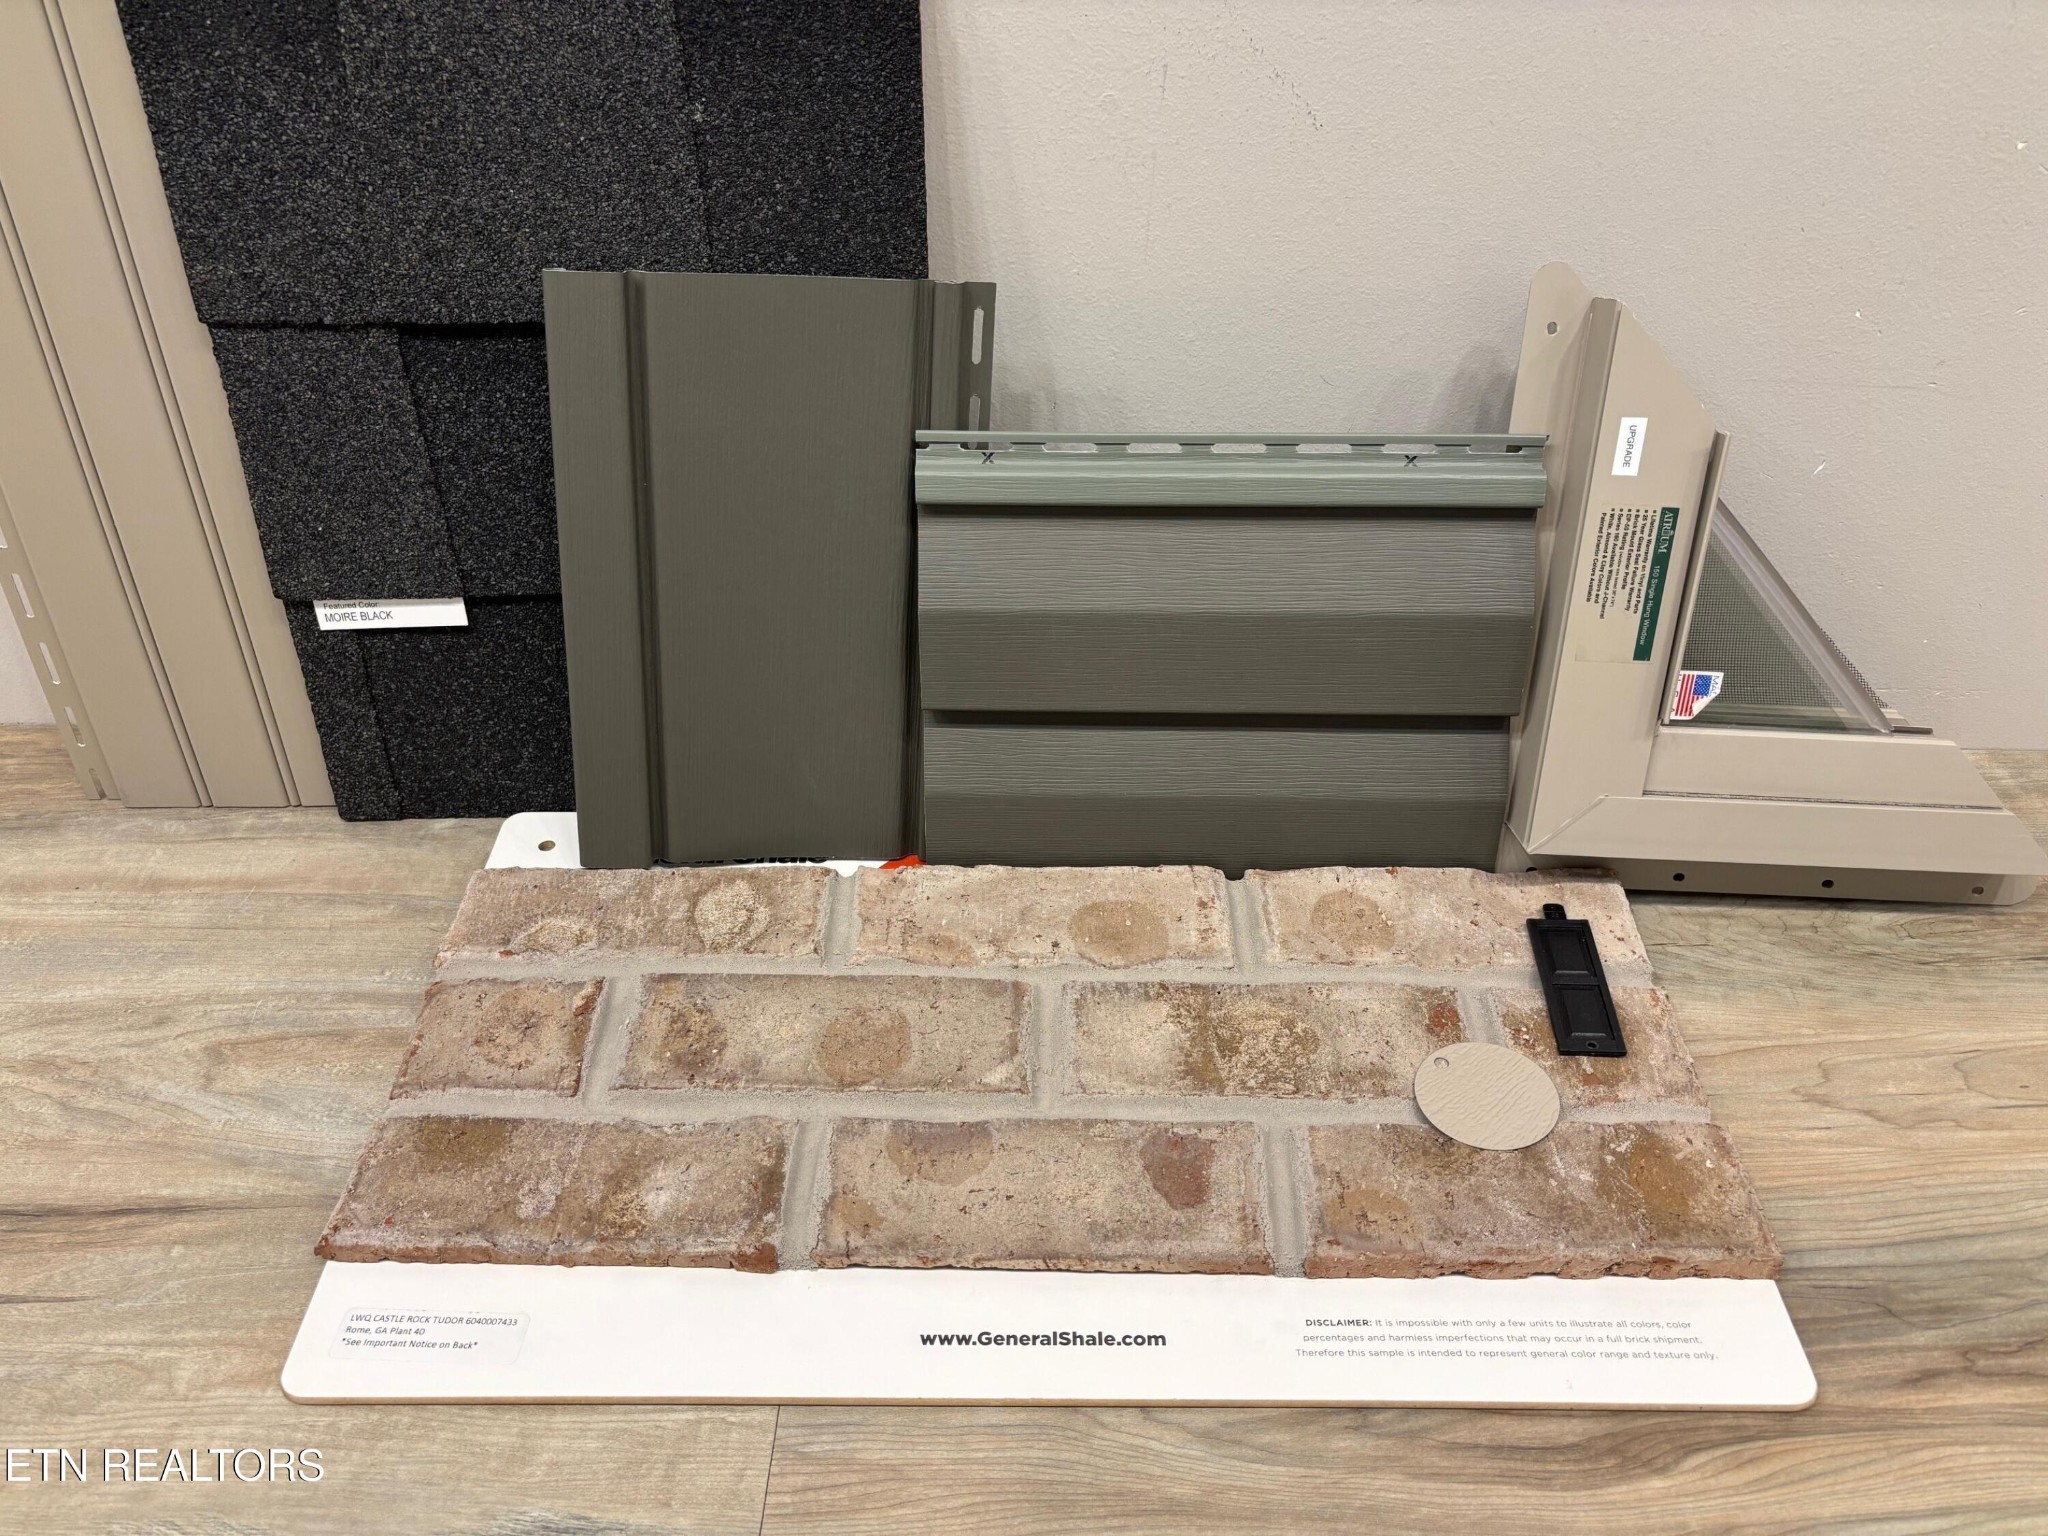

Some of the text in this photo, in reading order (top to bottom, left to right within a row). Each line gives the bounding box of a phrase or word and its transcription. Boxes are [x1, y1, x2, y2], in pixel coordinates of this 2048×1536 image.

[1622, 424, 1638, 468] UPGRADE
[1597, 512, 1606, 533] Painted
[1615, 513, 1623, 531] Series
[1647, 514, 1656, 537] Lifetime
[1594, 534, 1602, 556] Exterior
[1602, 531, 1611, 553] Almond
[1618, 531, 1628, 550] Rating
[1628, 530, 1636, 547] Mould
[1608, 542, 1617, 568] Available
[1624, 548, 1633, 570] Exterior
[1641, 538, 1652, 563] Warranty
[1598, 560, 1606, 572] Clay
[1630, 566, 1638, 585] Failure
[1596, 573, 1604, 592] Colors
[1604, 568, 1612, 590] Without
[1620, 571, 1629, 589] Profile
[1648, 578, 1657, 598] Single
[1586, 577, 1594, 602] Available
[1624, 586, 1634, 611] Warranty
[323, 602, 357, 610] Featured
[1643, 600, 1653, 617] Hung
[324, 610, 394, 622] MOIRE BLACK
[1639, 618, 1649, 644] Window
[351, 1314, 371, 1322] LWQ
[434, 1316, 464, 1324] TUDOR
[466, 1318, 517, 1326] 6040007433
[1396, 1319, 1448, 1327] impossible
[1476, 1320, 1496, 1328] only
[1508, 1319, 1525, 1327] few
[1630, 1321, 1664, 1329] colors,
[345, 1326, 371, 1335] Rome,
[390, 1327, 412, 1335] Plant
[920, 1331, 1166, 1346] www.GeneralShale.com
[1436, 1334, 1504, 1342] imperfections
[1653, 1336, 1702, 1344] shipment.
[363, 1339, 407, 1348] Important
[409, 1340, 437, 1348] Notice
[1418, 1349, 1462, 1357] intended
[1479, 1350, 1527, 1358] represent
[1530, 1350, 1568, 1359] general
[1571, 1350, 1596, 1358] color
[1600, 1352, 1628, 1360] range
[1694, 1352, 1718, 1360] only.
